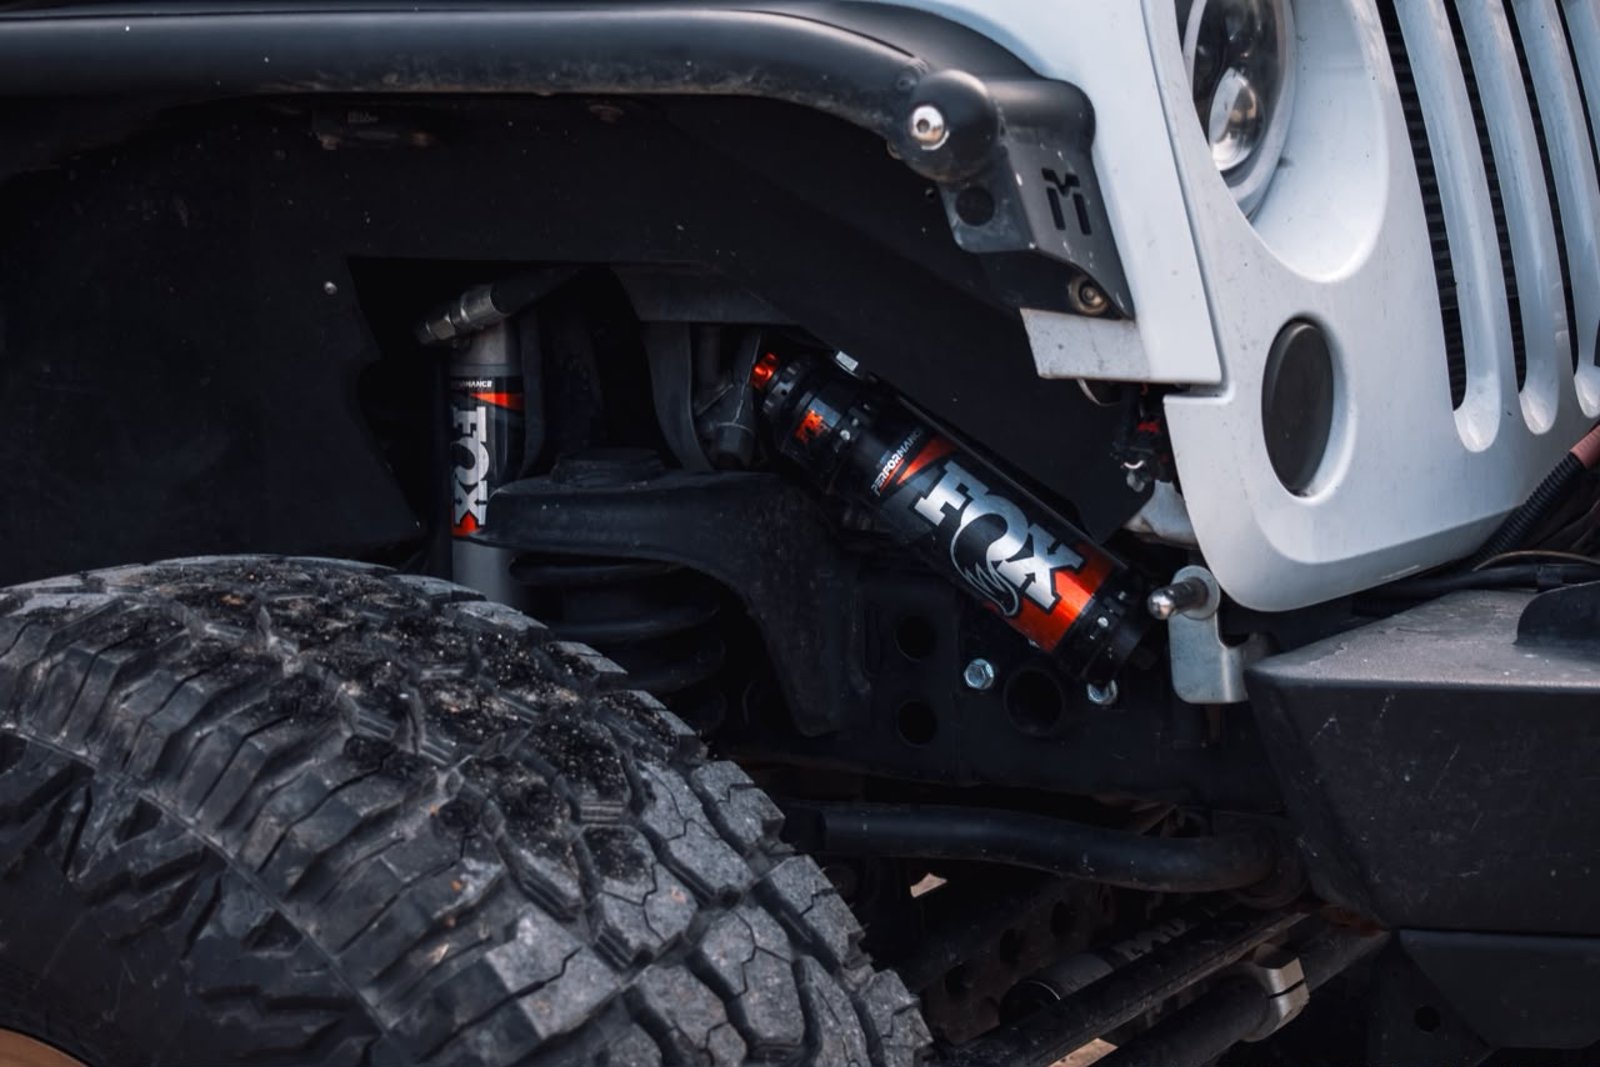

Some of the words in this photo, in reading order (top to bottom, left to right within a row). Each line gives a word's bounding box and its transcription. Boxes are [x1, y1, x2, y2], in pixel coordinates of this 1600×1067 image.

[452, 406, 490, 525] FOX
[870, 428, 923, 497] PERFORMANC
[915, 460, 1084, 612] FOX
